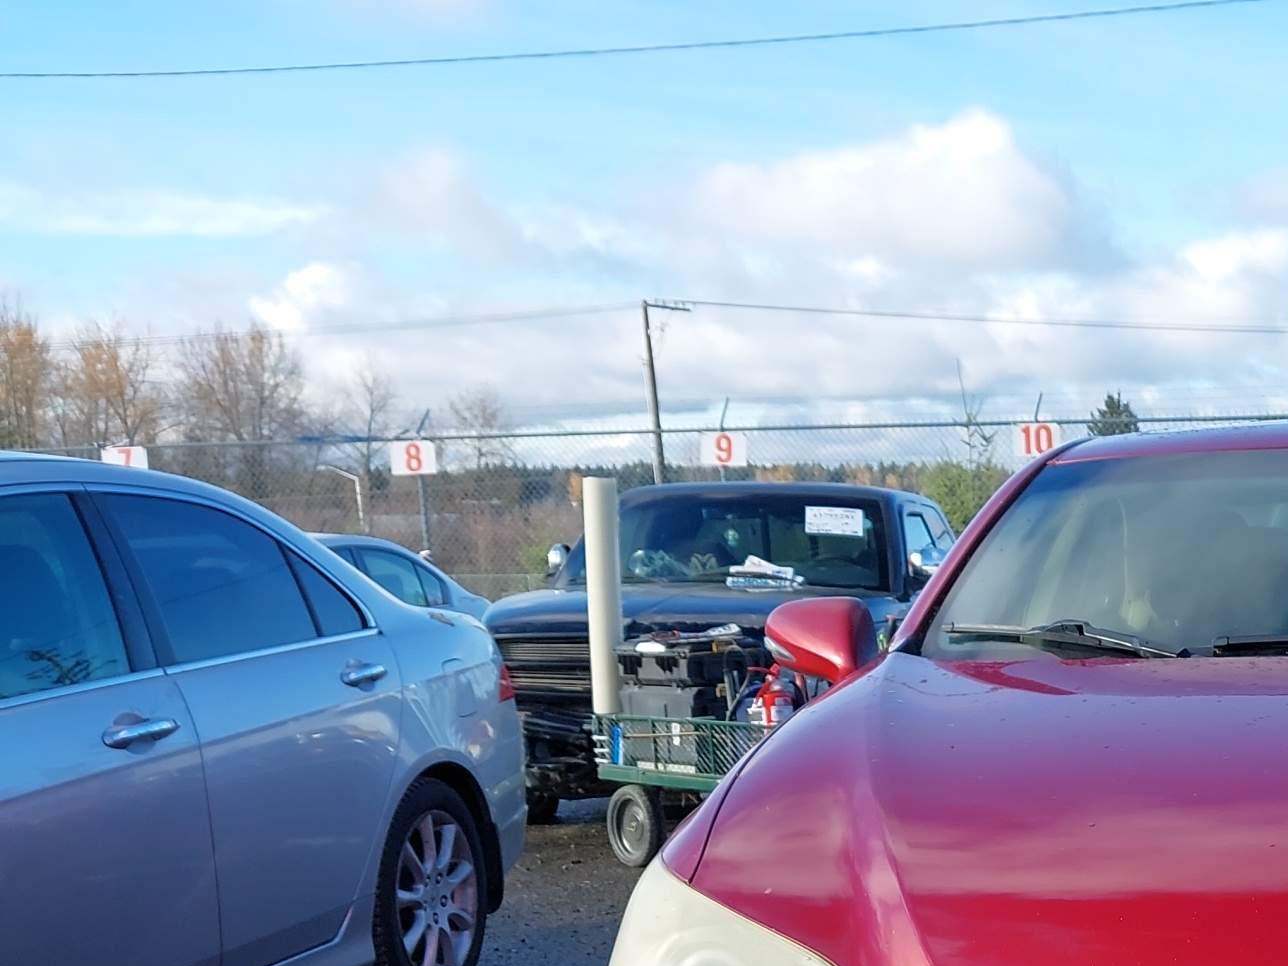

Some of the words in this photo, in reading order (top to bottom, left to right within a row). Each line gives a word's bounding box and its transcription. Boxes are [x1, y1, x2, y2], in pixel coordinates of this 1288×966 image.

[714, 434, 732, 463] 9
[1021, 424, 1054, 455] 10
[117, 448, 131, 465] 7
[405, 443, 421, 471] 8
